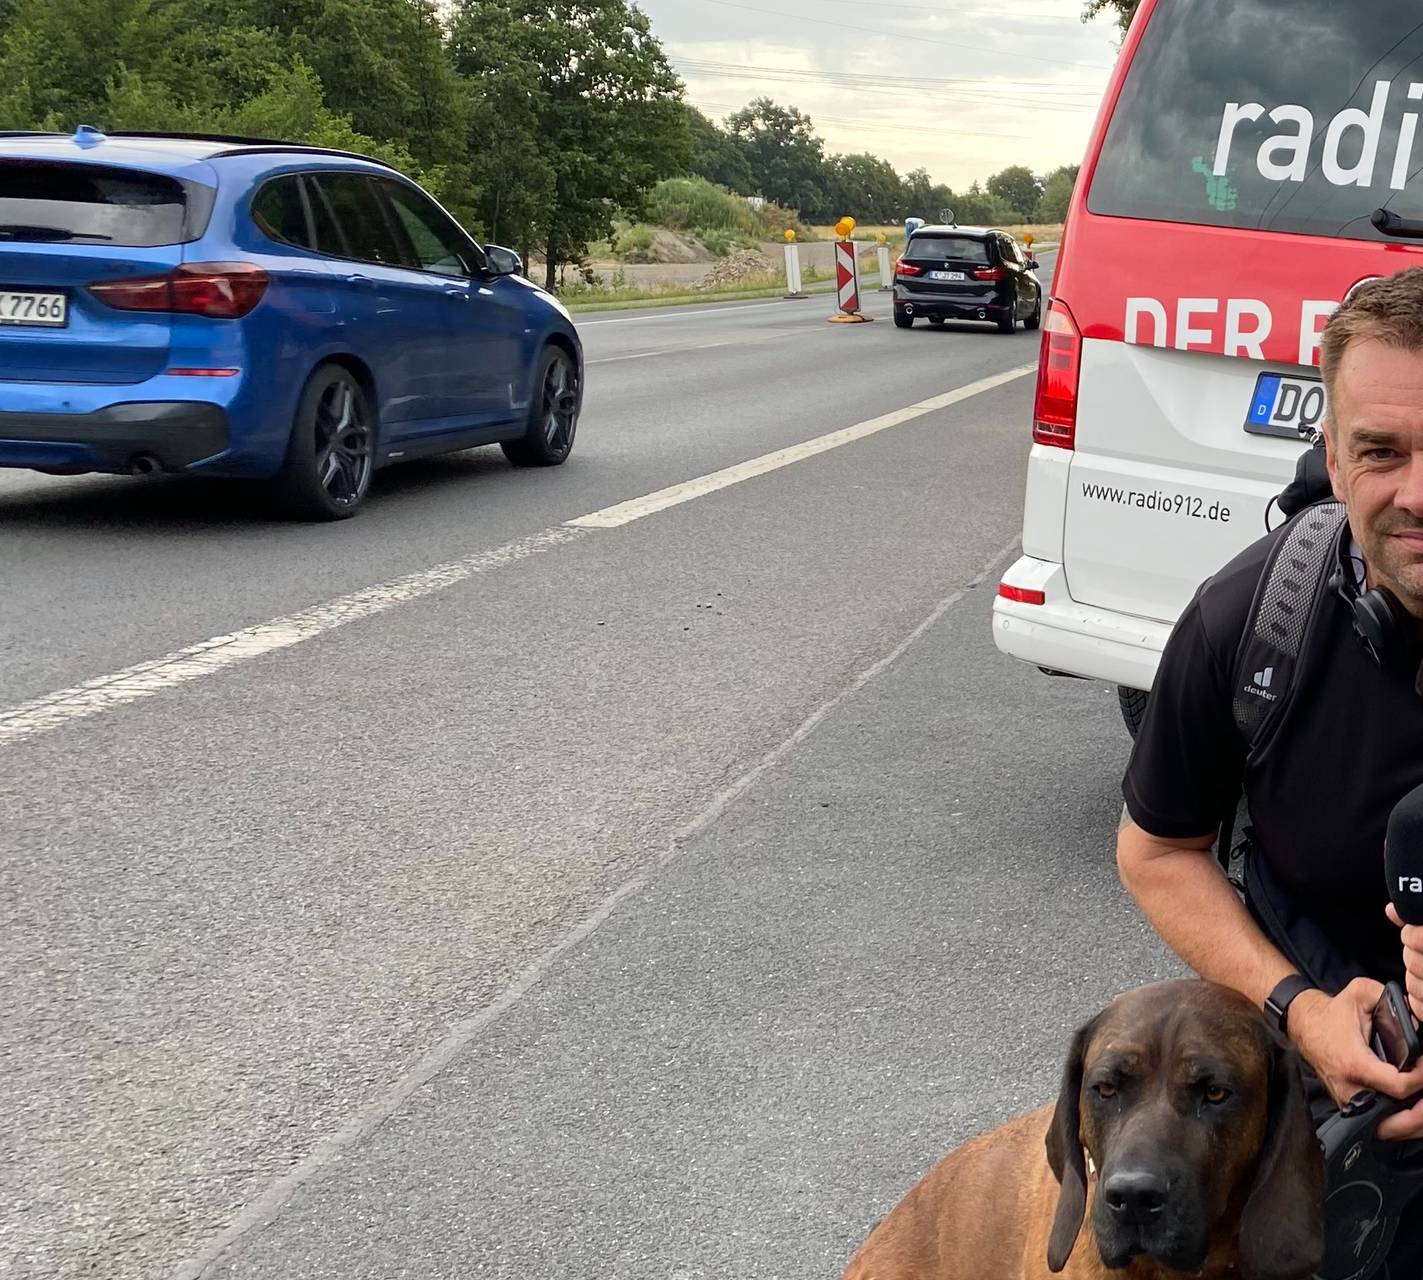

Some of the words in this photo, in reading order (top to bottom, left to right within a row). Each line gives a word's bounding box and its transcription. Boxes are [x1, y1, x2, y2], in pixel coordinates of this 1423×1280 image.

[10, 295, 61, 318] 7766
[1082, 482, 1231, 523] www.radio912.de
[1243, 684, 1278, 702] deuter
